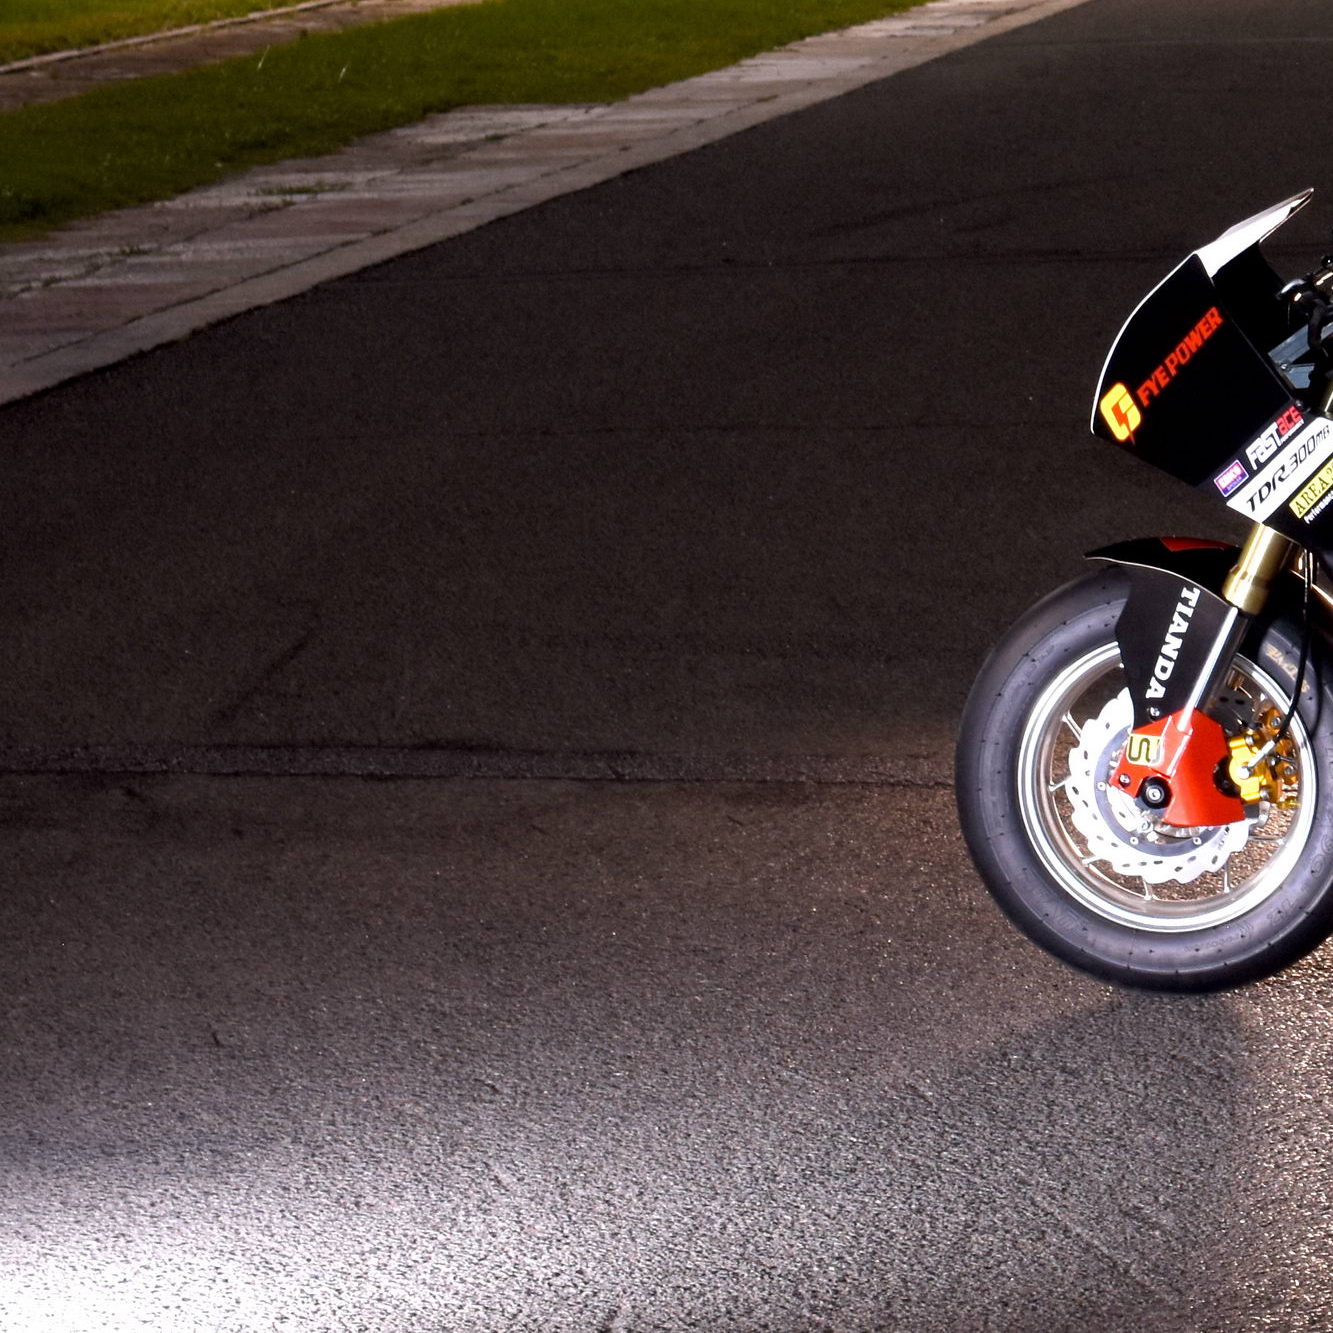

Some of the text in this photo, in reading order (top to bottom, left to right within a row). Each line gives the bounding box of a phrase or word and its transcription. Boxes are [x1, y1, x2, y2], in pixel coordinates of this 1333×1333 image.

[1136, 306, 1224, 408] FYE POWER
[1295, 475, 1329, 515] AREA
[1145, 587, 1200, 700] TIANDA
